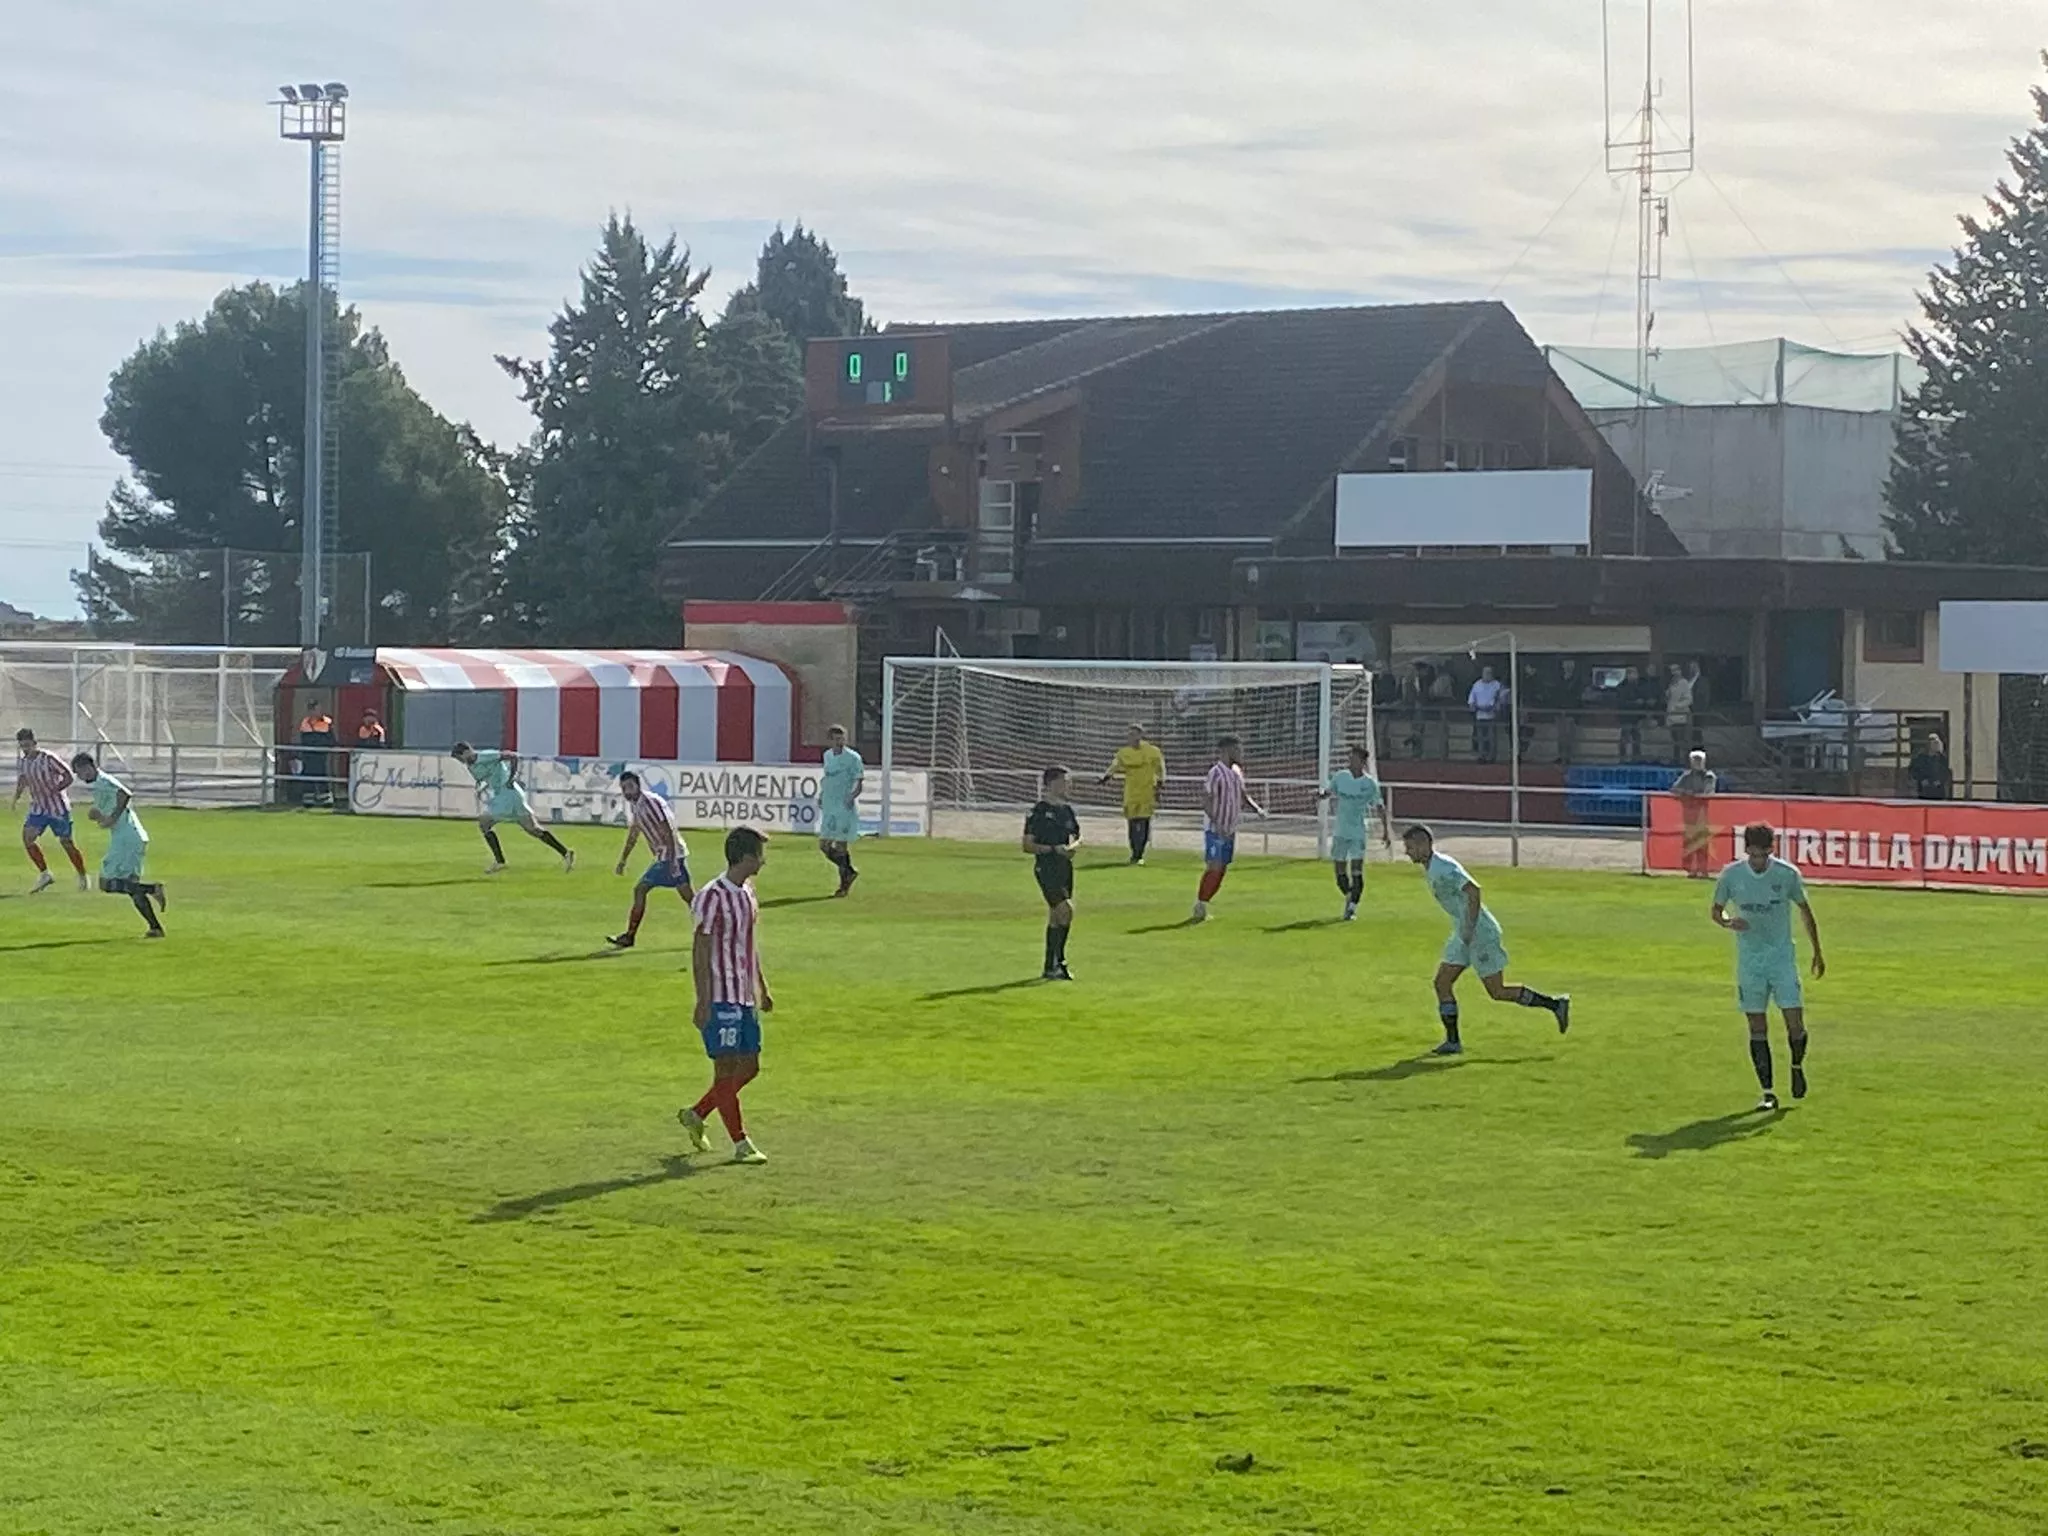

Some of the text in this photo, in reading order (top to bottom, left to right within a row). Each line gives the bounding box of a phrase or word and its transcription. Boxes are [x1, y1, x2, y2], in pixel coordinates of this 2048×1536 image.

[850, 352, 907, 378] 0 0
[695, 799, 815, 823] BARBASTRO
[1733, 826, 2047, 874] ETRELLA DAMM
[718, 1027, 737, 1047] 18
